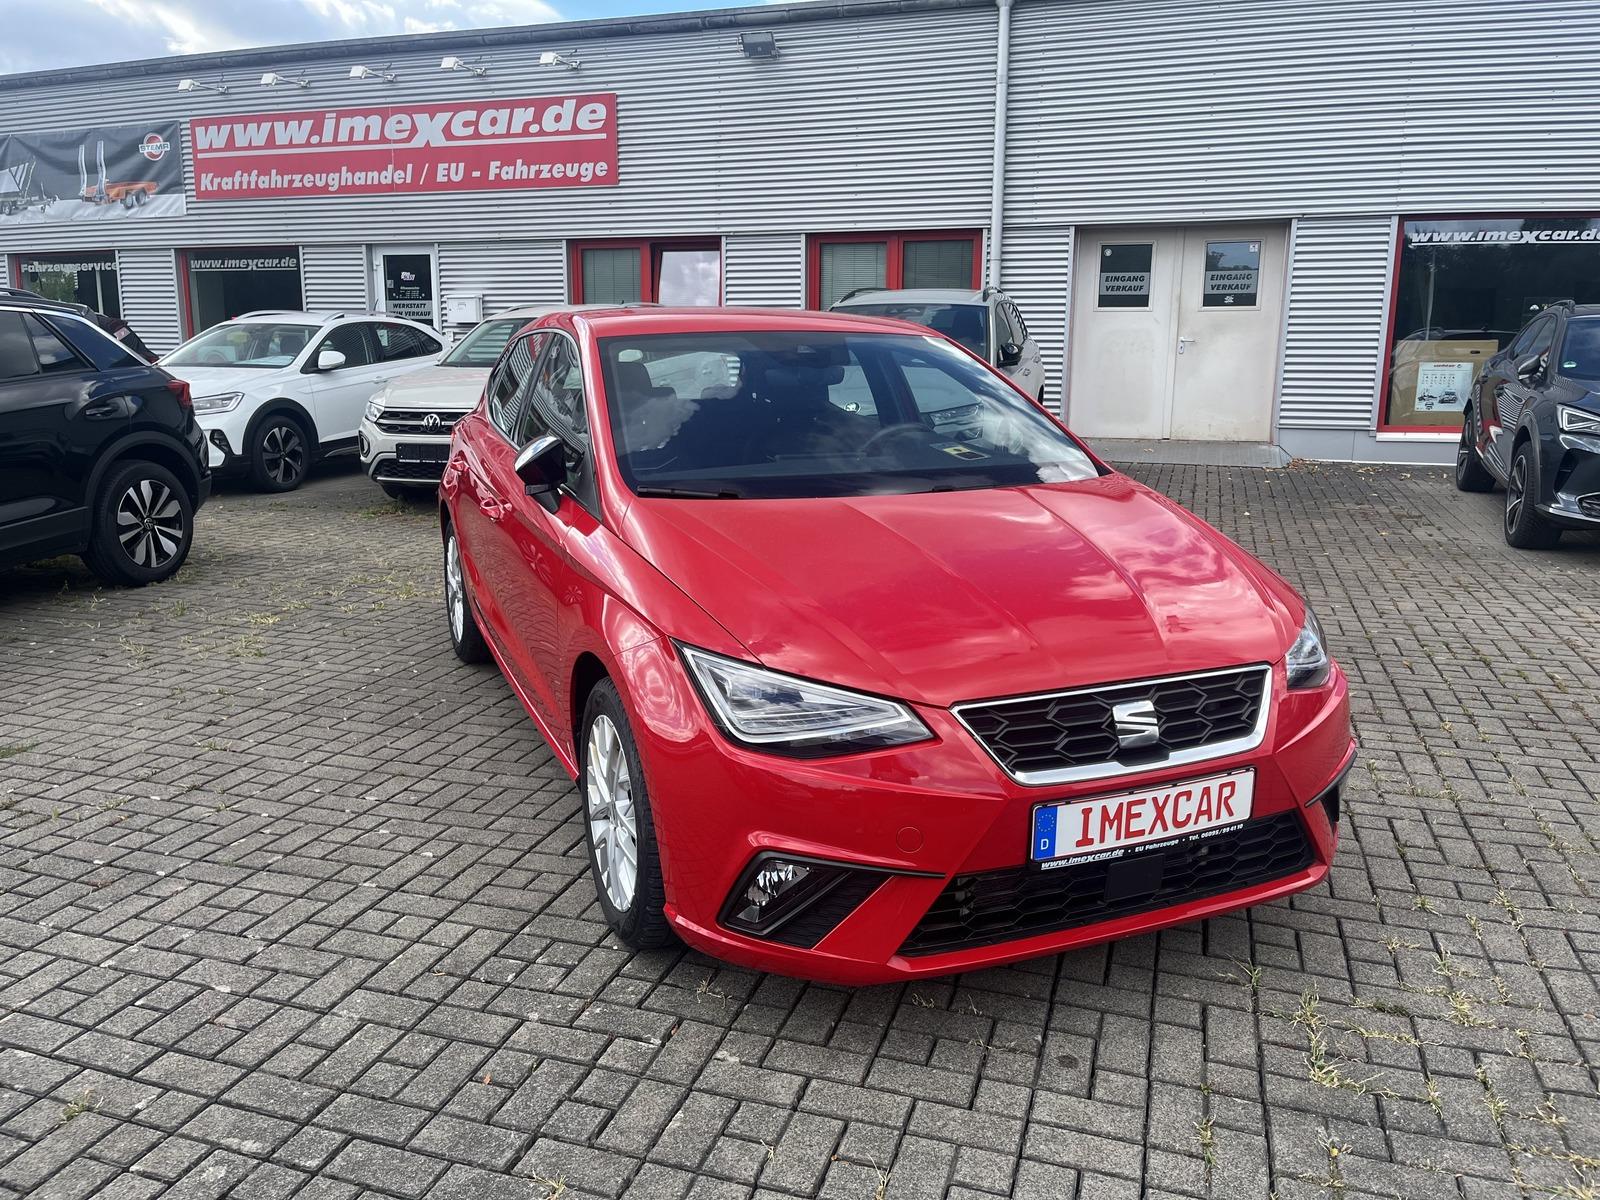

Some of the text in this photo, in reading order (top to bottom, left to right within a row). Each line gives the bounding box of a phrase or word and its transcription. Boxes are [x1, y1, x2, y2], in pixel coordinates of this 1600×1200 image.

[194, 99, 607, 150] www.imexcar.de
[200, 163, 413, 191] Kraftfahrzeughandel
[436, 162, 466, 183] EU
[488, 158, 608, 182] Fahrzeuge
[190, 256, 297, 270] www.imexcar.de
[1210, 273, 1253, 281] EINGANG
[1210, 283, 1252, 291] VERKAUF
[1076, 781, 1236, 848] IMEXCAR
[1040, 838, 1049, 850] D
[1041, 849, 1125, 869] www.imexcar.de
[1145, 839, 1179, 851] Fahrzeuge
[1189, 833, 1200, 841] Tel.
